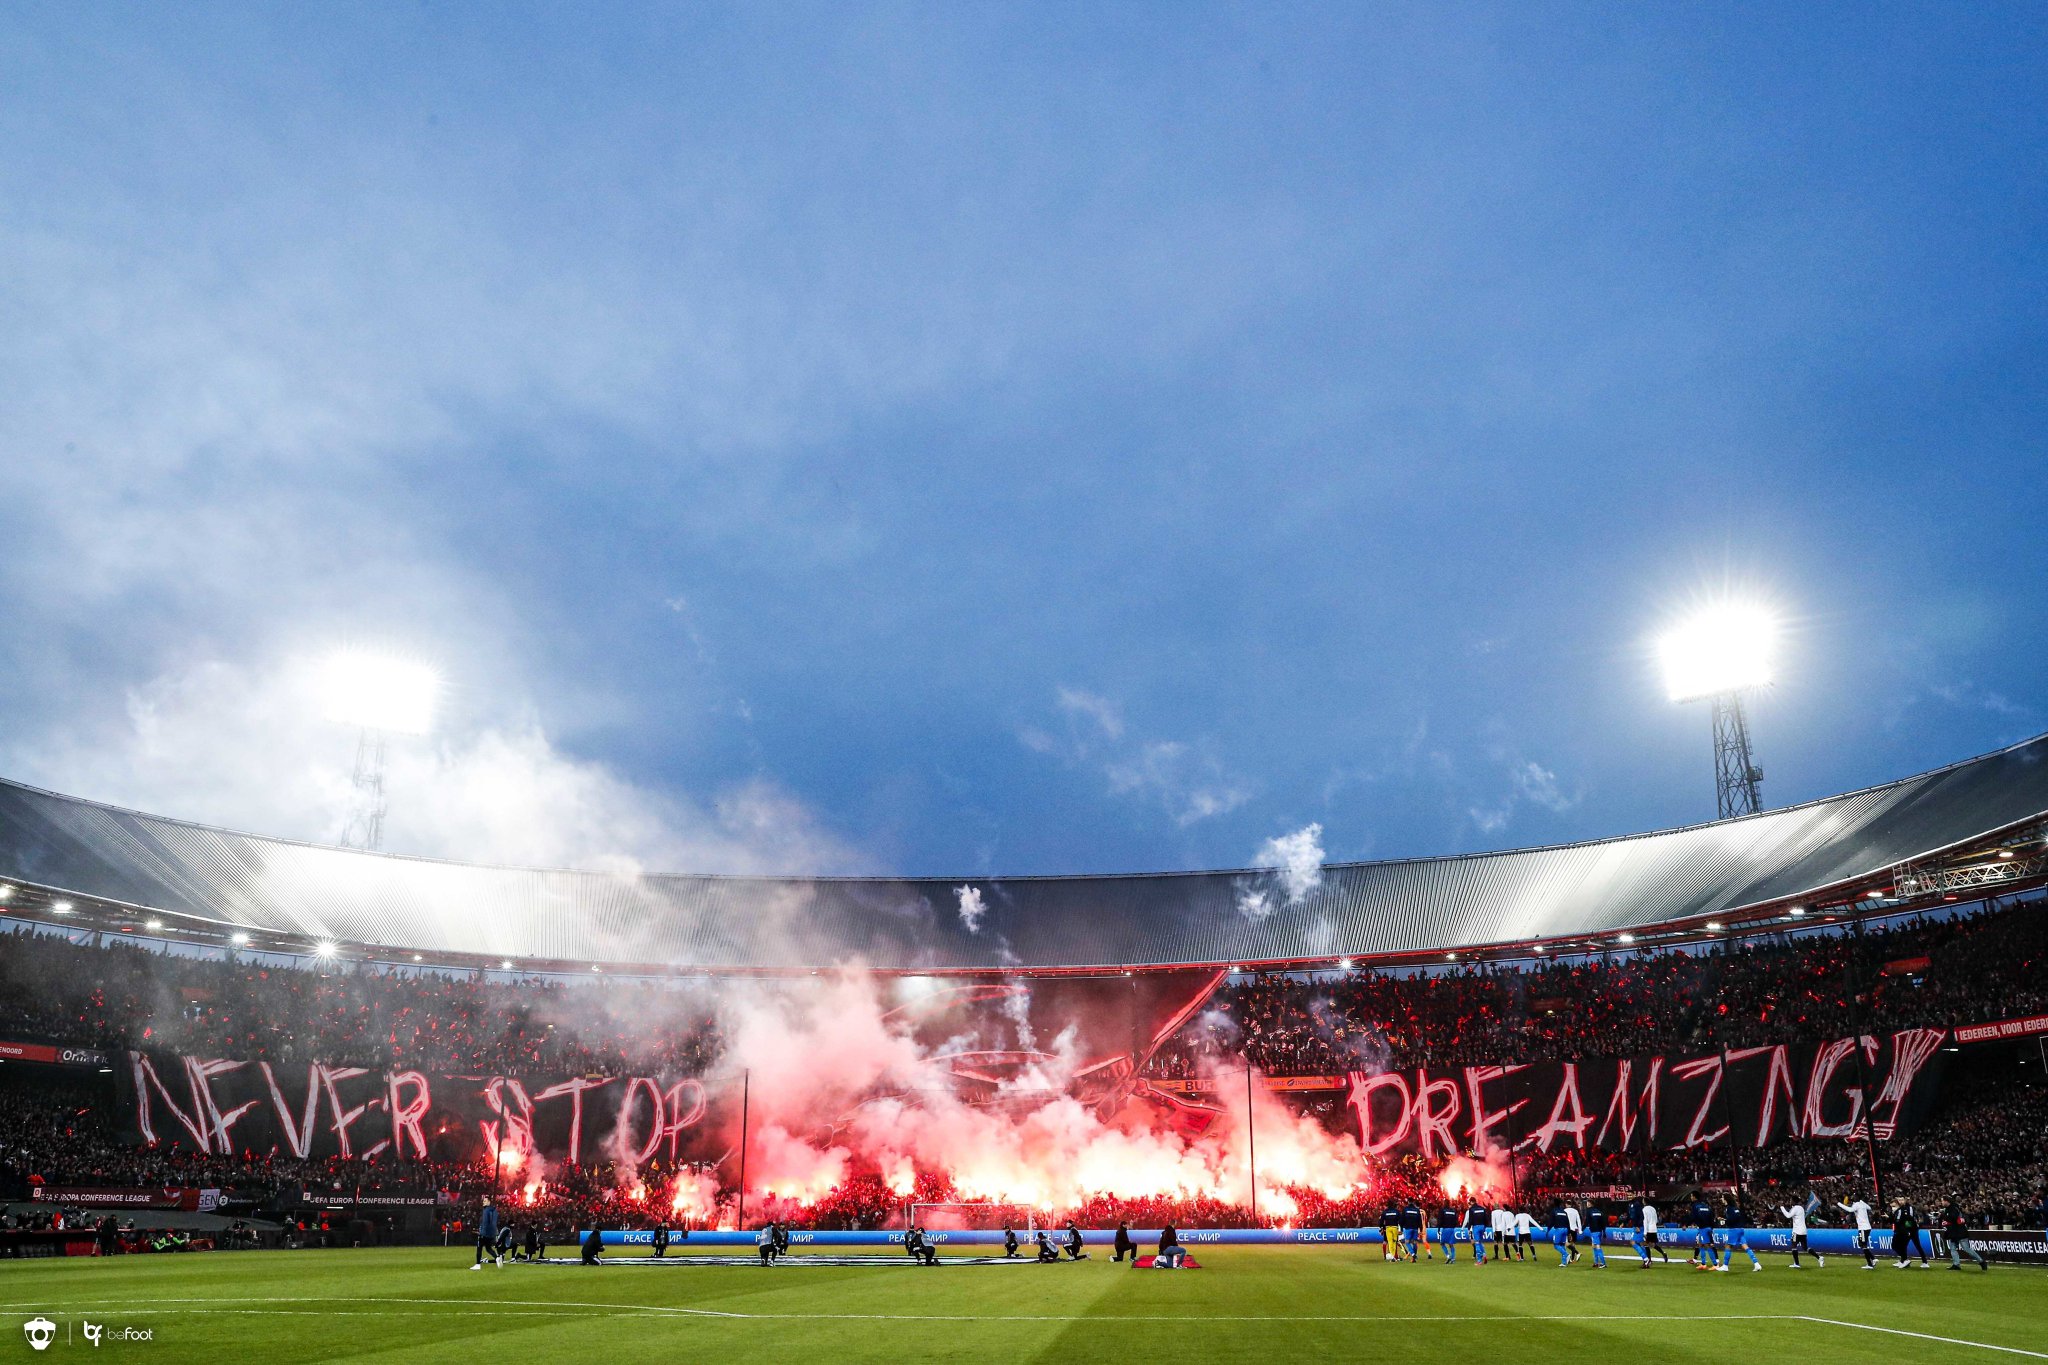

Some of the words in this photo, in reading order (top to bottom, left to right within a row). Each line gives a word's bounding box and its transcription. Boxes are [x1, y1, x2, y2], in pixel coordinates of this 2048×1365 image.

[1959, 1026, 2000, 1040] IEDEREEN,
[2000, 1022, 2022, 1035] VOOR
[129, 1050, 431, 1161] NEVER
[479, 1076, 707, 1165] STOP
[80, 1194, 124, 1202] CONFERENCE
[624, 1234, 652, 1243] PEACE
[669, 1234, 682, 1243] ИР
[792, 1234, 814, 1243] МИР
[889, 1234, 906, 1242] PEA
[1198, 1232, 1221, 1242] МИР
[1298, 1231, 1328, 1241] PEACE
[1336, 1231, 1359, 1241] МИР
[1988, 1240, 2034, 1253] CONFERENCE
